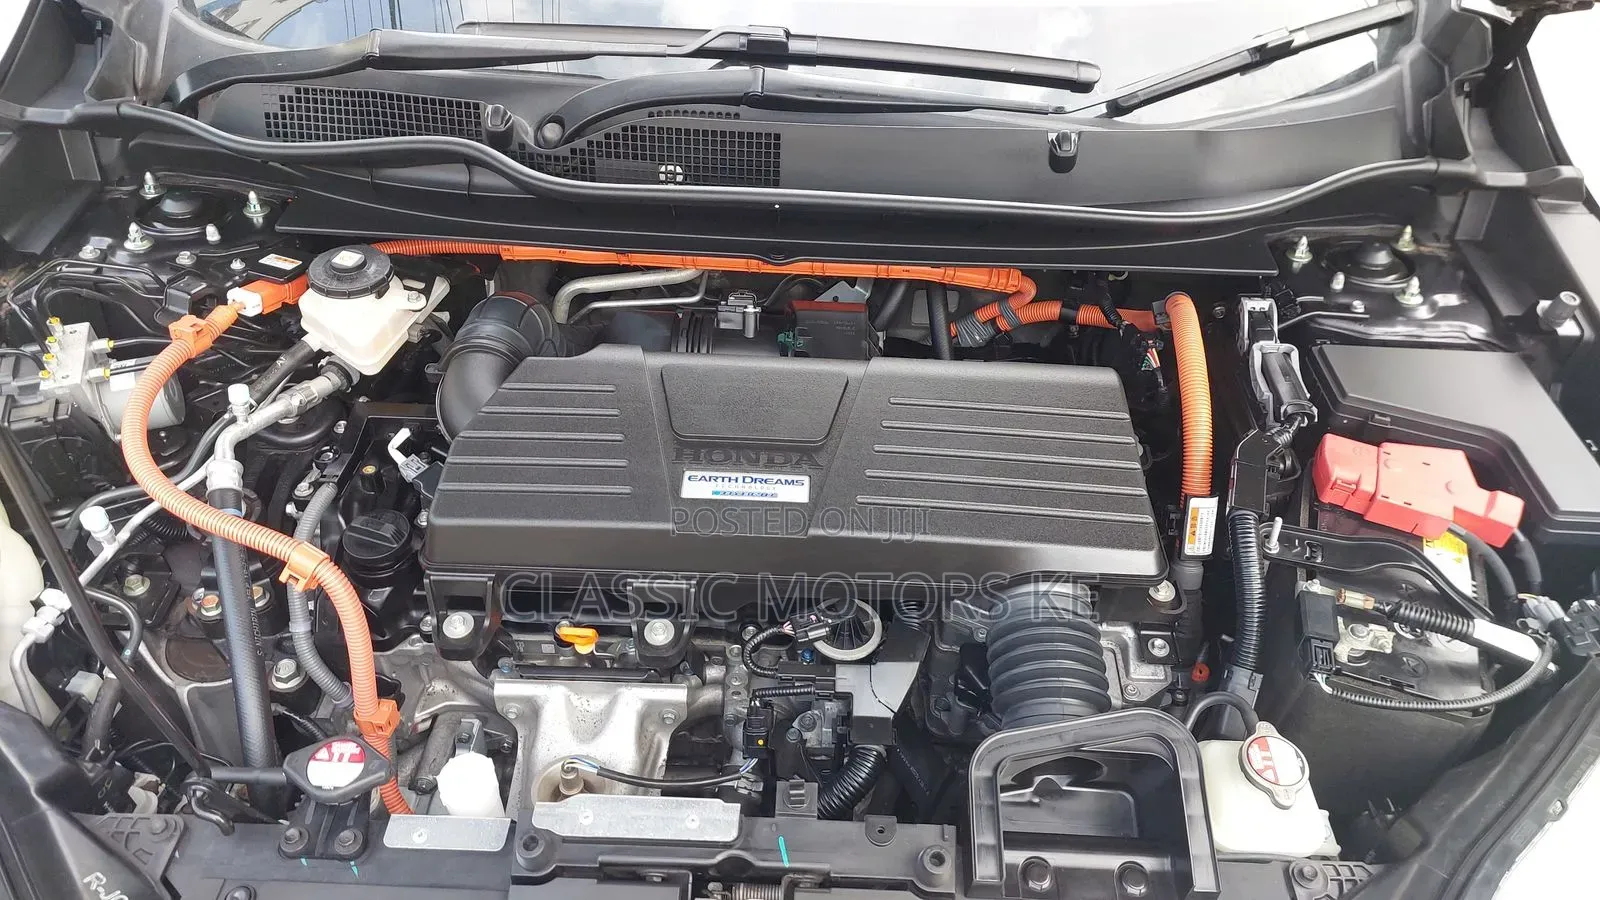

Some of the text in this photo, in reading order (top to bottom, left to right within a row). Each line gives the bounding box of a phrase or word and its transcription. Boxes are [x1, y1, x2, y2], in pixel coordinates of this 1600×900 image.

[672, 448, 823, 469] HONDA
[687, 474, 805, 487] EARTH DREAMS
